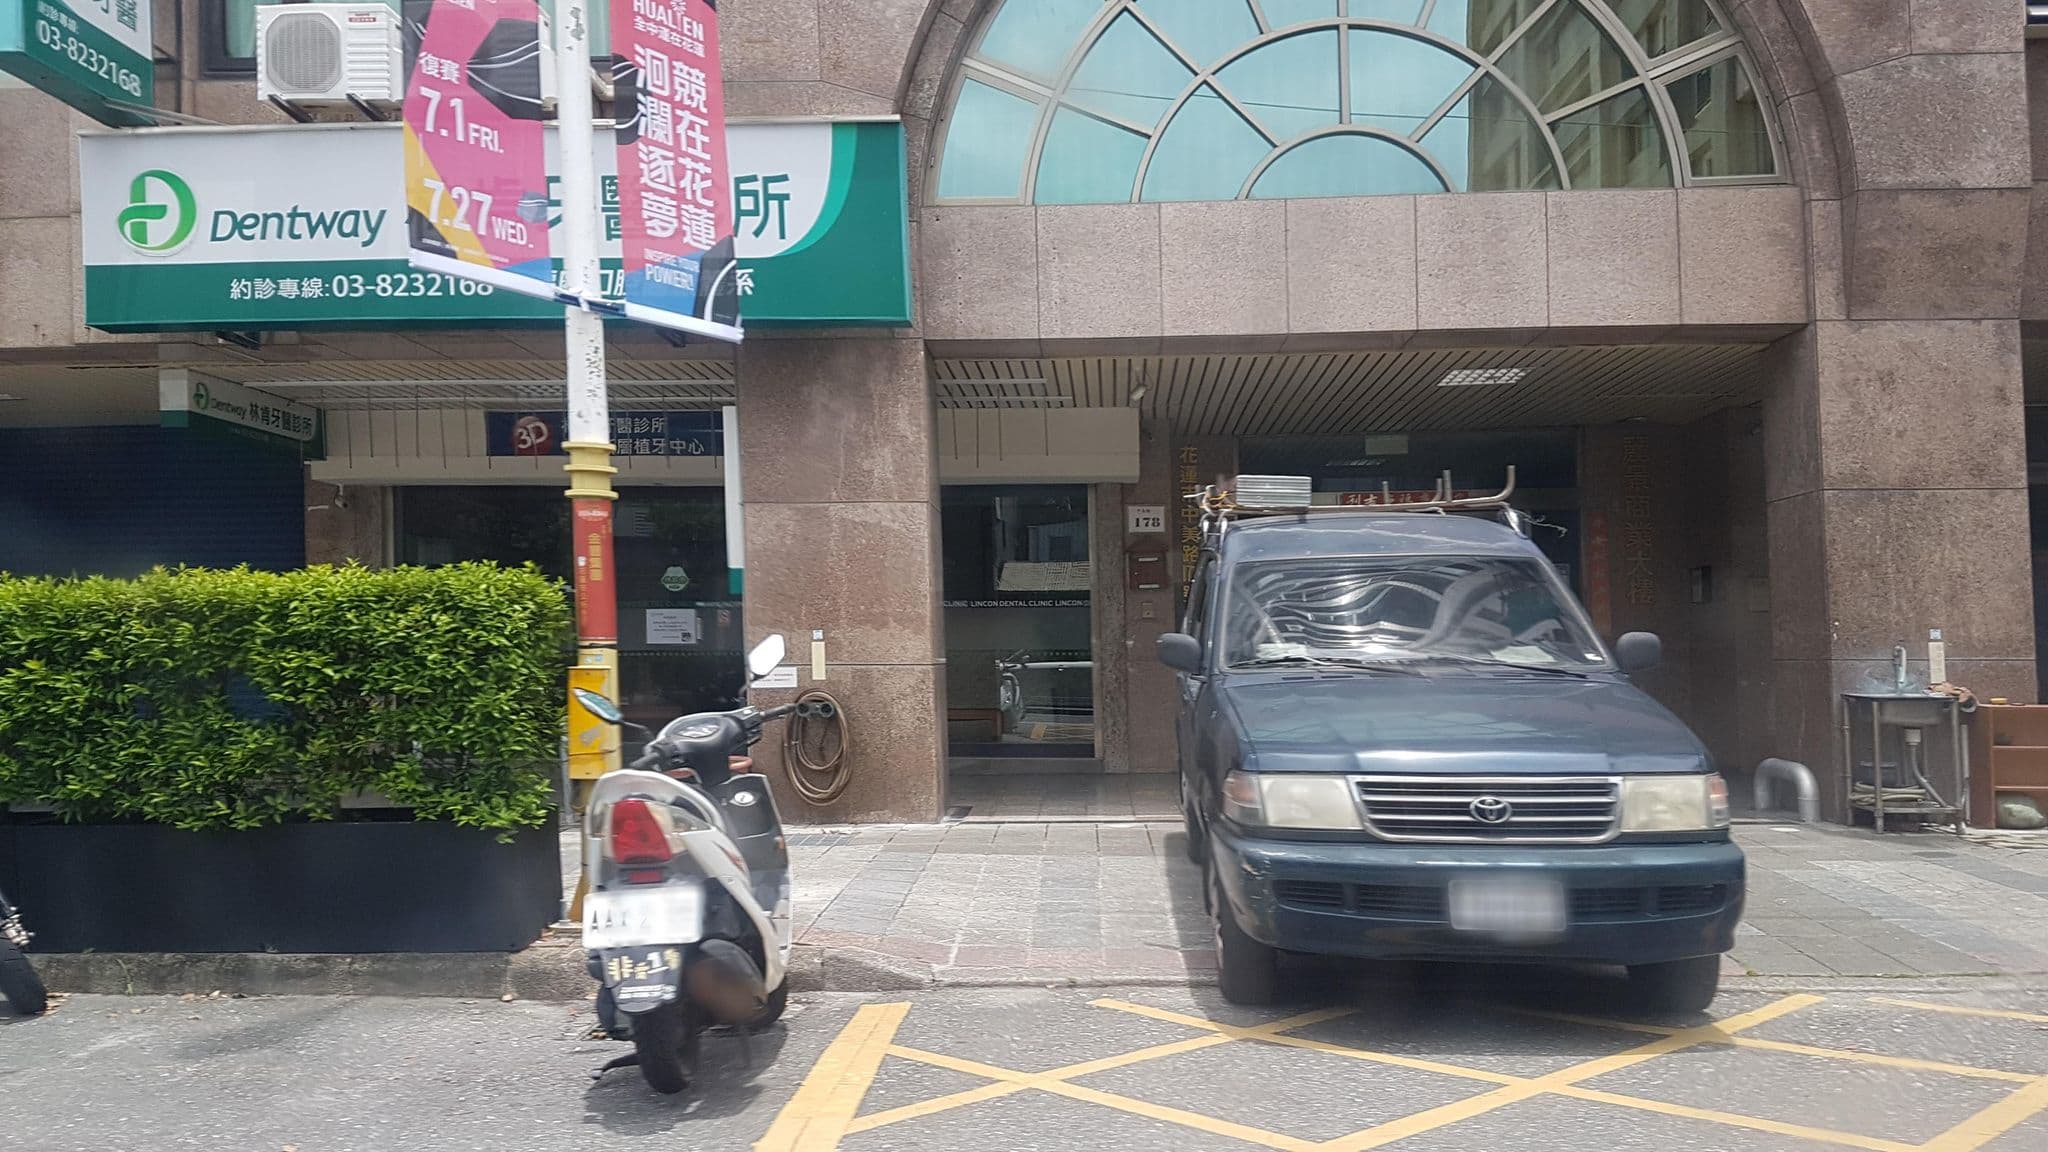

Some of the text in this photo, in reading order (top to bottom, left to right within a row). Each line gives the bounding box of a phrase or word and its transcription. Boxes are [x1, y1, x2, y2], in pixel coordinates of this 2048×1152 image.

[633, 0, 704, 41] HUALIEN
[36, 19, 142, 98] 03-8232168
[419, 52, 460, 85] 復賽
[419, 86, 504, 154] 7.1 FRI.
[634, 43, 678, 239] 洄瀾逐夢
[672, 60, 716, 251] 競在花蓮
[210, 204, 387, 247] Dentway
[423, 177, 493, 236] 7.27
[491, 215, 535, 250] WED.
[230, 277, 330, 299] 約診專線:
[211, 398, 247, 421] Dentway
[516, 422, 549, 449] 3D
[1135, 517, 1160, 528] 178
[970, 599, 998, 607] LINCON
[999, 599, 1028, 607] DENTAL
[1028, 599, 1054, 607] CLINIC
[1054, 599, 1082, 607] LINCON
